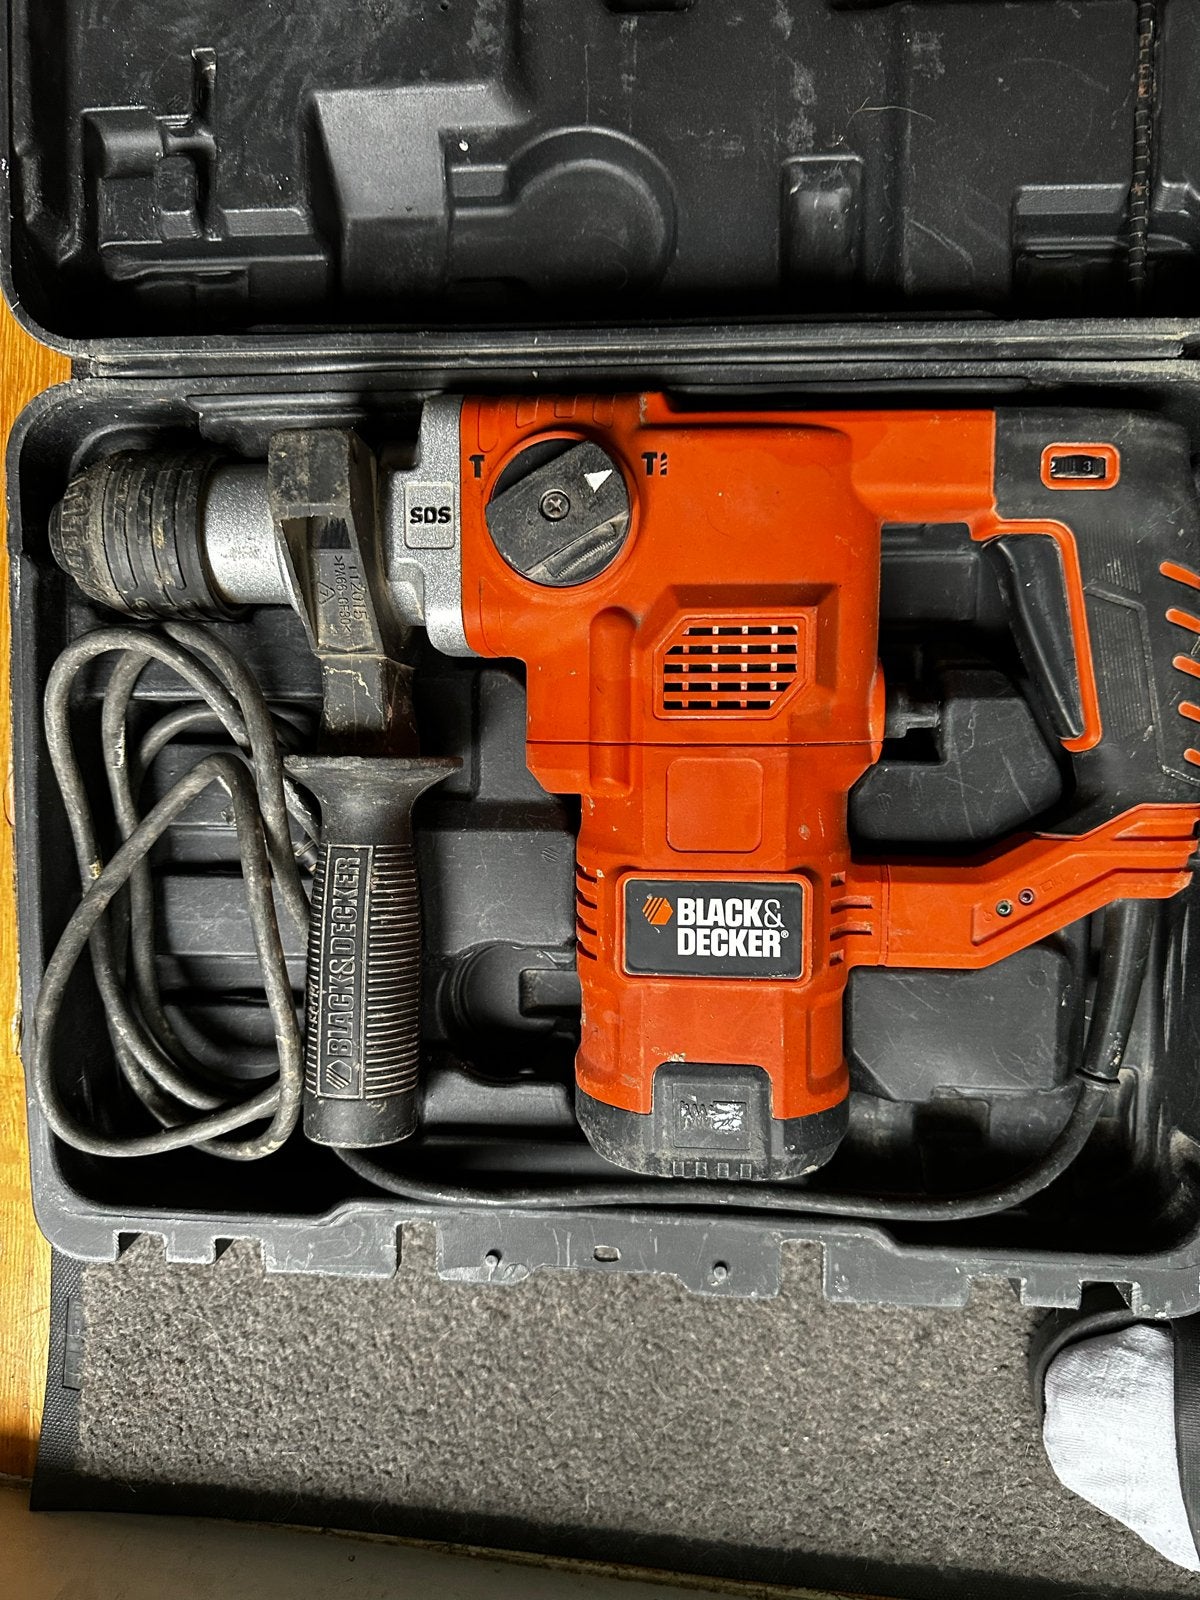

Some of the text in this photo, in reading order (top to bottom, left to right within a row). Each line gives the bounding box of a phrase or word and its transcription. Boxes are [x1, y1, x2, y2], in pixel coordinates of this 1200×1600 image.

[1083, 461, 1092, 472] 3
[410, 507, 451, 524] SDS
[677, 898, 785, 928] BLACK&
[326, 857, 360, 1056] BLACK&DECKER
